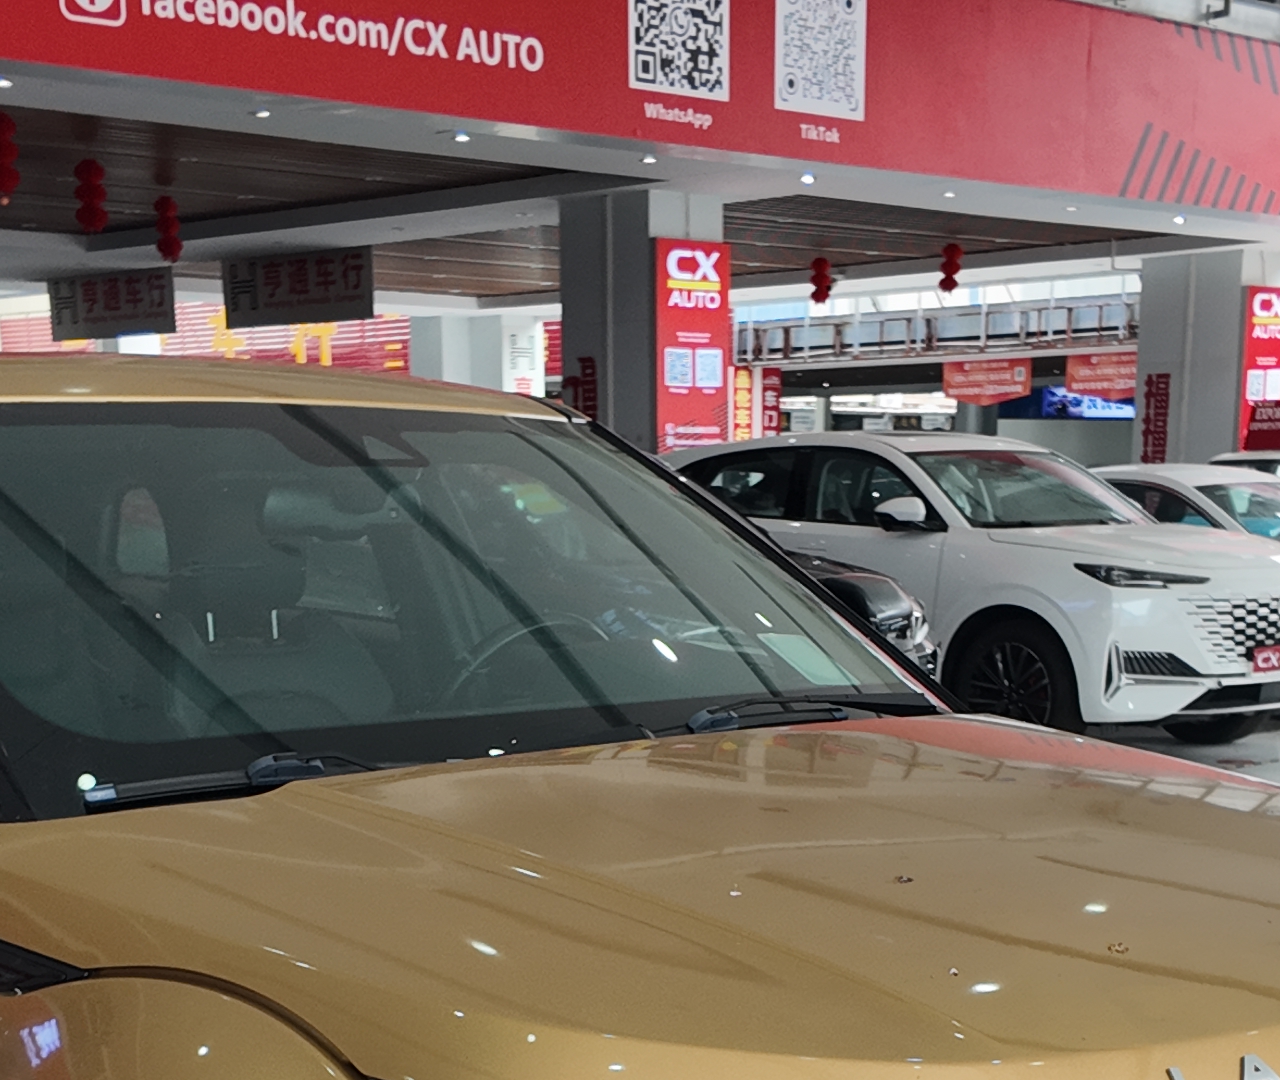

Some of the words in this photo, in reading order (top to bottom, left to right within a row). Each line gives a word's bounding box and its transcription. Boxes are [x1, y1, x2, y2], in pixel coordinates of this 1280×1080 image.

[456, 27, 545, 72] AUTO
[644, 102, 713, 130] WhatsApp
[799, 123, 841, 144] TikTok
[665, 248, 720, 282] CX
[667, 289, 721, 310] AUTO
[1256, 651, 1280, 669] CX
